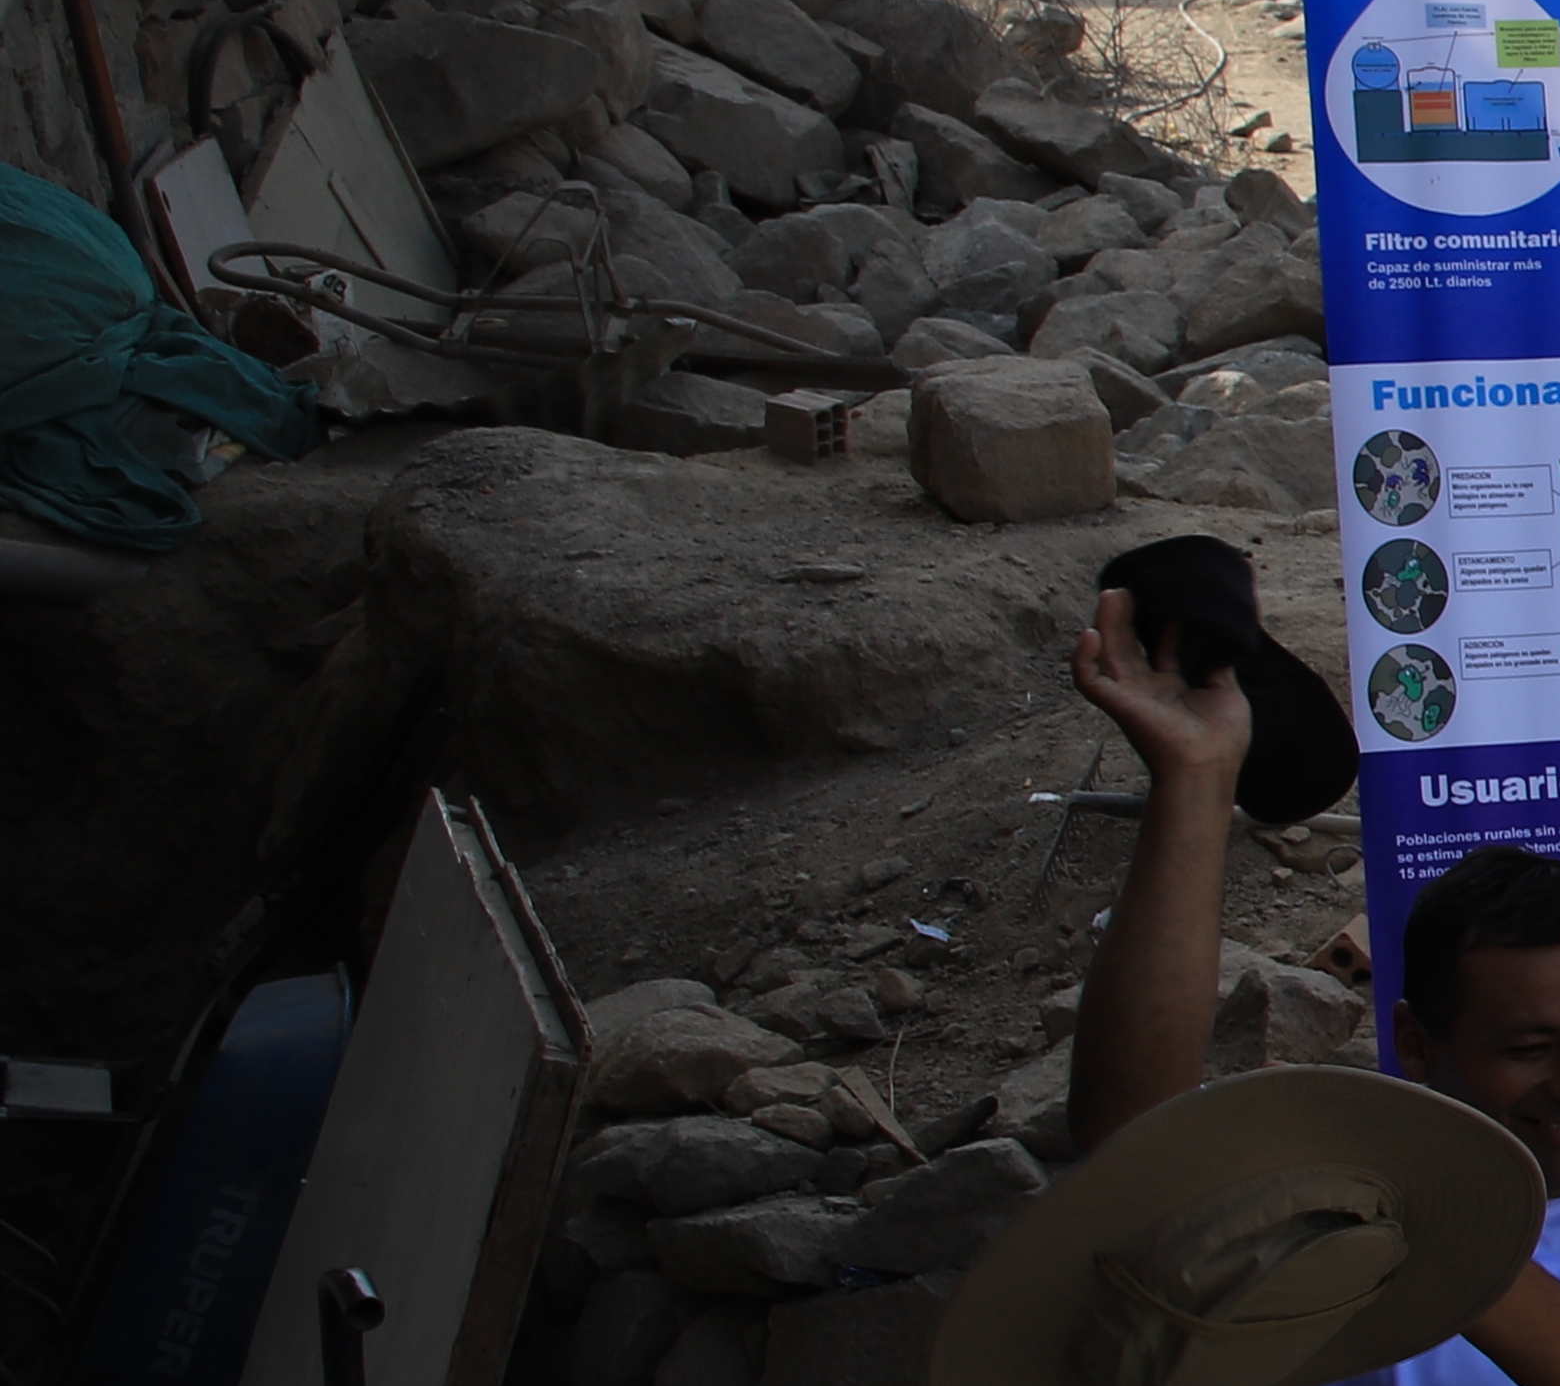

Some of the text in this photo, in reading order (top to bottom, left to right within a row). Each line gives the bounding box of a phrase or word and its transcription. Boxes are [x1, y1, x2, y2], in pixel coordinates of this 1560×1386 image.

[1365, 232, 1428, 251] Filtro
[1367, 258, 1542, 276] Capaz de suministrar más
[1368, 274, 1492, 290] de 2500 Lt. diarios
[1396, 831, 1481, 846] Poblaciones
[1484, 826, 1531, 840] rurales
[1534, 824, 1556, 837] sin
[1396, 853, 1414, 863] se
[1416, 848, 1463, 862] estima
[1398, 867, 1415, 879] 15
[146, 1182, 262, 1381] TRUPER
